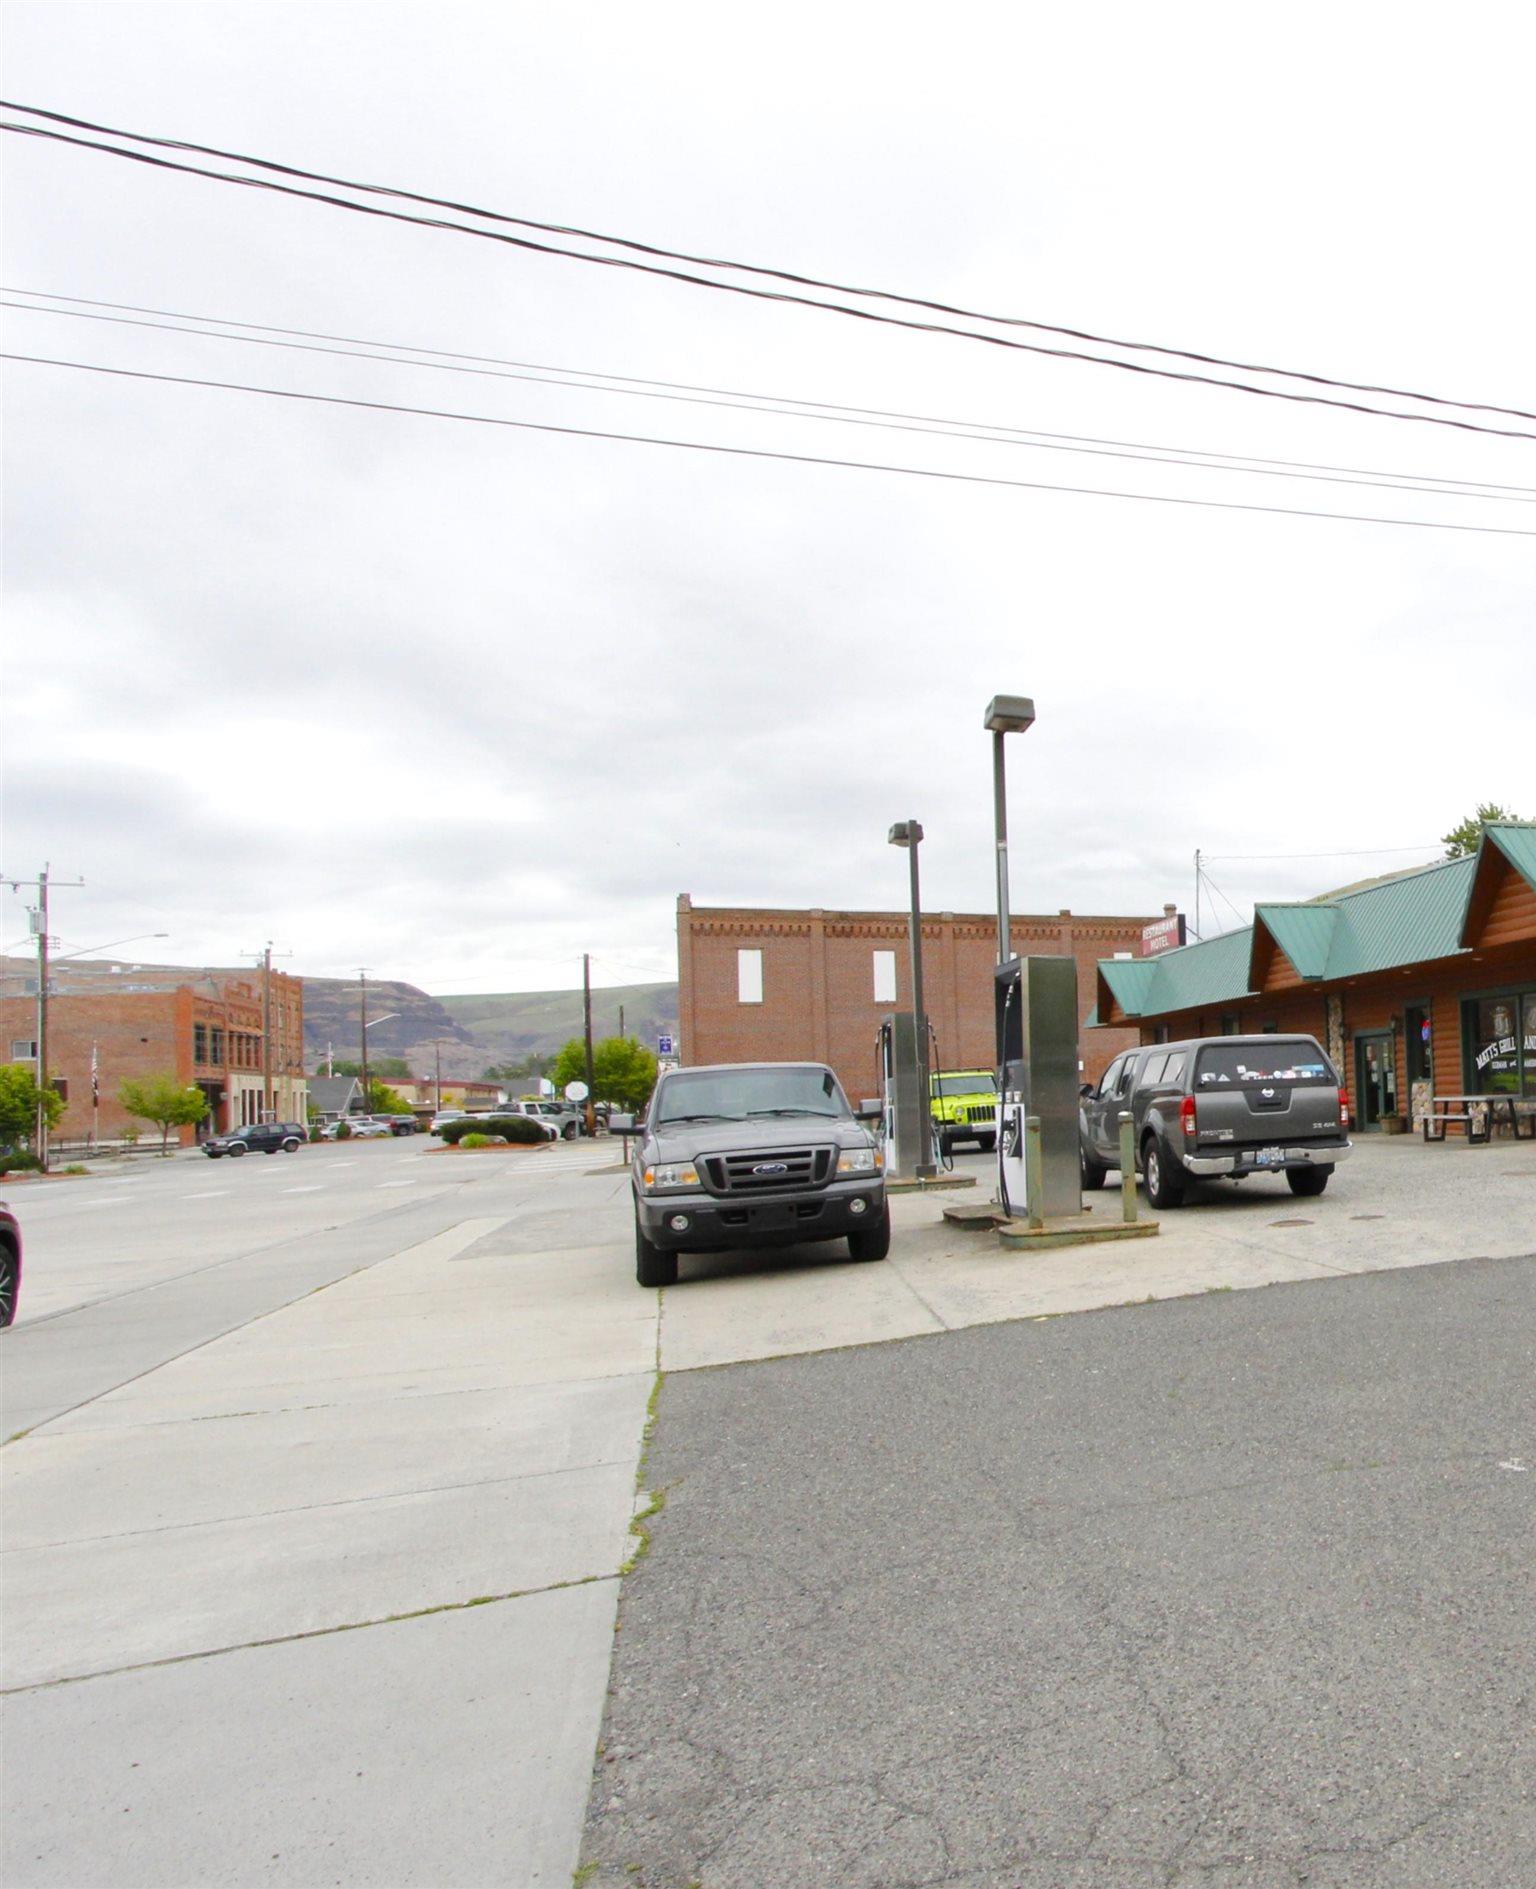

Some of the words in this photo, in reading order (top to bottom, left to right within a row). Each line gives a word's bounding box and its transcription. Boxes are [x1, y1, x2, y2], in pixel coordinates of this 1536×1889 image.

[1142, 916, 1178, 940] RESTAURANT
[1150, 935, 1169, 951] MOTEL
[1499, 1036, 1516, 1053] GRILL
